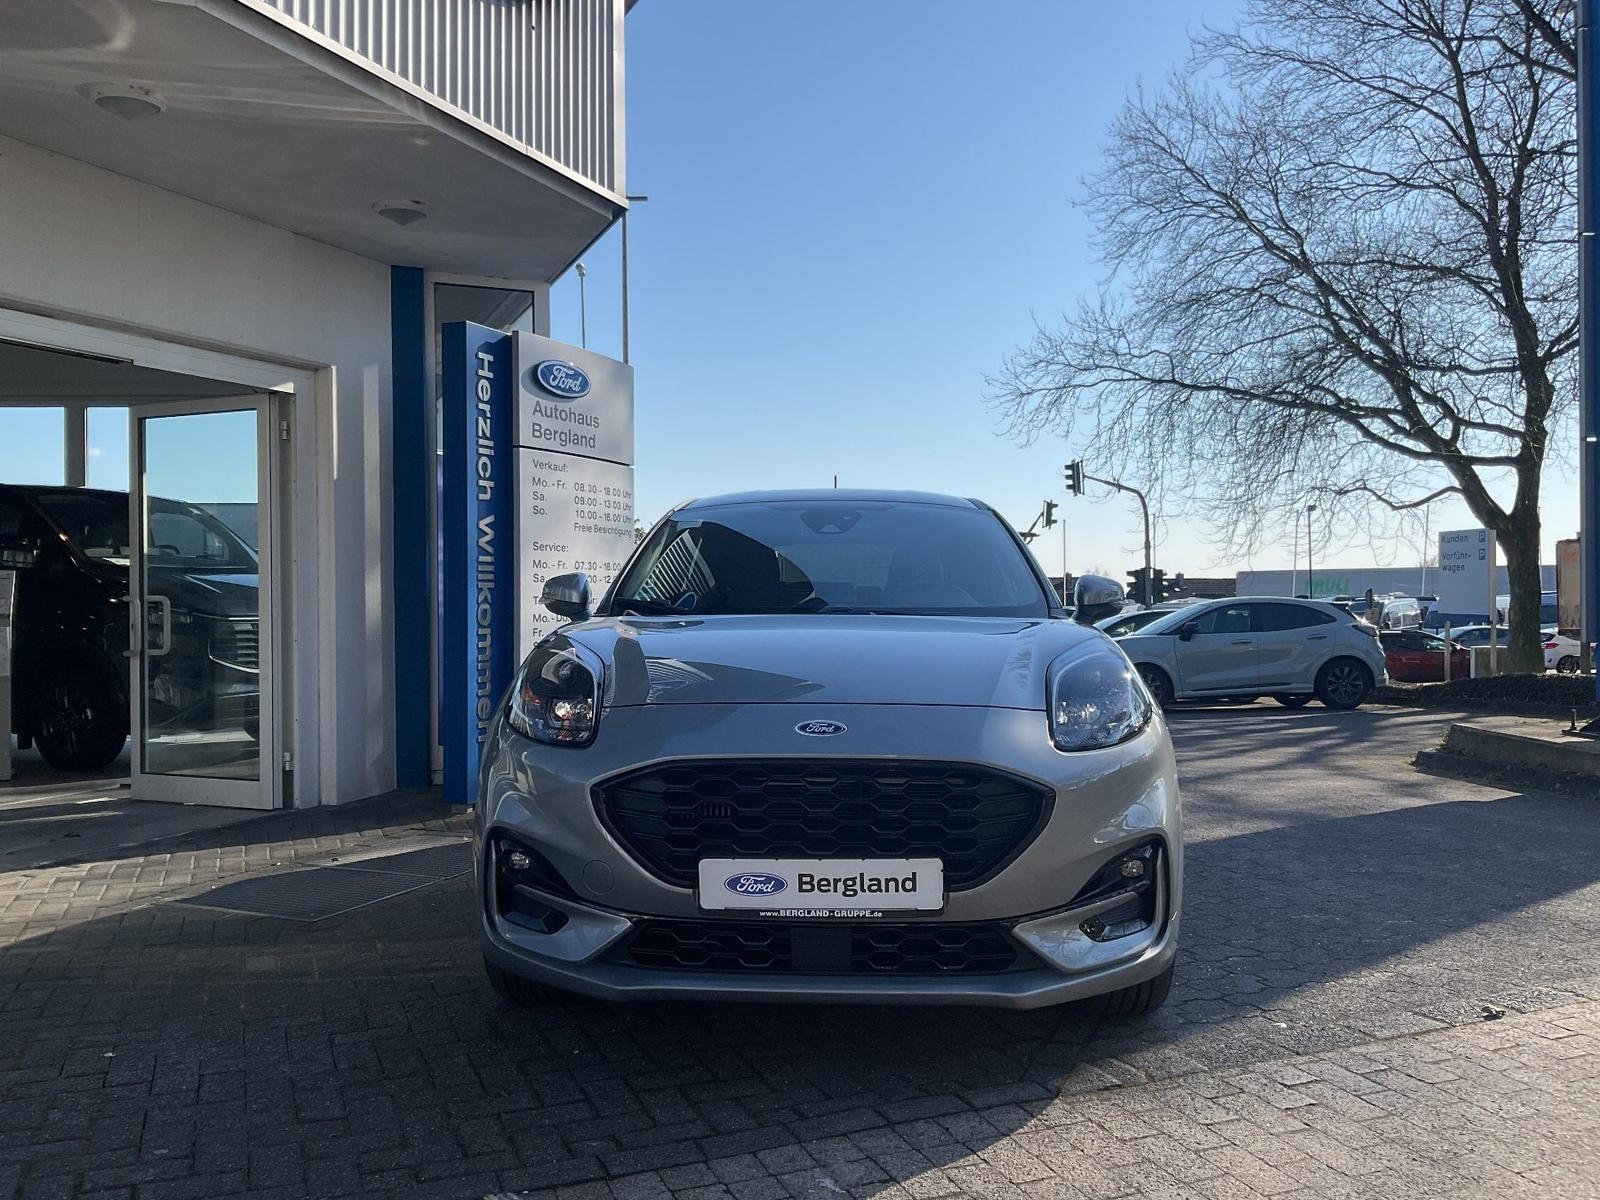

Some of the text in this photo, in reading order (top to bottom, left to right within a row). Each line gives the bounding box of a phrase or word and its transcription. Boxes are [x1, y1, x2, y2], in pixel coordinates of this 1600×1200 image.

[532, 400, 600, 428] Autohaus
[532, 422, 596, 448] Bergland
[532, 459, 569, 473] Verkauf:
[532, 477, 550, 488] Mo.
[556, 480, 568, 489] Fr.
[574, 482, 597, 494] 08.30
[604, 487, 621, 498] 18.00
[622, 490, 632, 499] Uhr
[532, 491, 547, 501] Sa.
[574, 496, 597, 507] 09.00
[604, 500, 621, 510] 13.00
[622, 503, 632, 511] Uhr
[532, 505, 548, 515] So.
[575, 509, 597, 520] 10.00
[604, 513, 621, 523] 16.00
[574, 522, 593, 533] Freie
[477, 351, 495, 742] Herzlich Willkommen
[532, 541, 569, 553] Service:
[532, 560, 550, 569] Mo.
[557, 561, 568, 570] Fr.
[574, 561, 597, 571] 07.30
[604, 562, 621, 572] 18.00
[532, 614, 549, 623] Mo.
[532, 628, 544, 637] Fr.
[797, 872, 918, 898] Bergland
[759, 909, 883, 918] www.BERGLAND-GRUPPE.de
